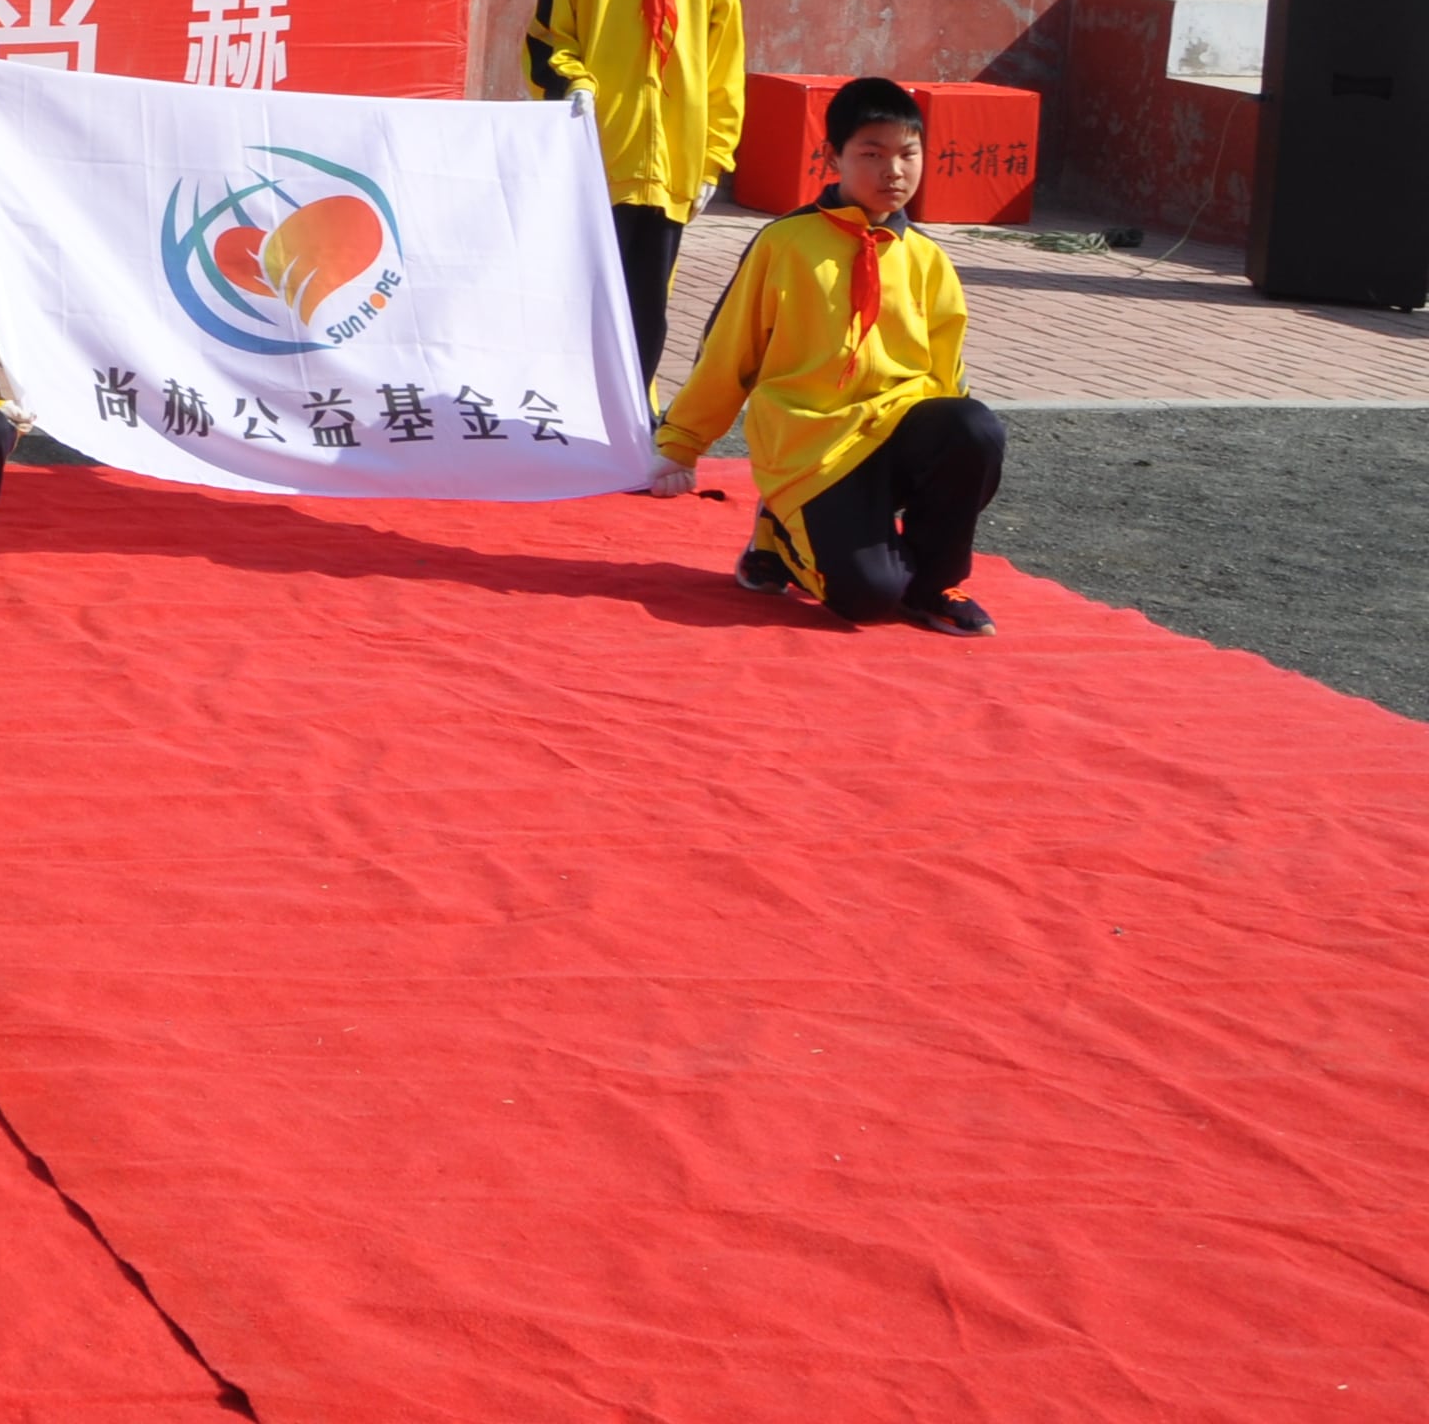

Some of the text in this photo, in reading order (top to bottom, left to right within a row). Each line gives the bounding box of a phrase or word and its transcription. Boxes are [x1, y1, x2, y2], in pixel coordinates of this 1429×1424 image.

[325, 268, 402, 345] SUN HOPE
[92, 366, 569, 447] 尚赫公益基金会
